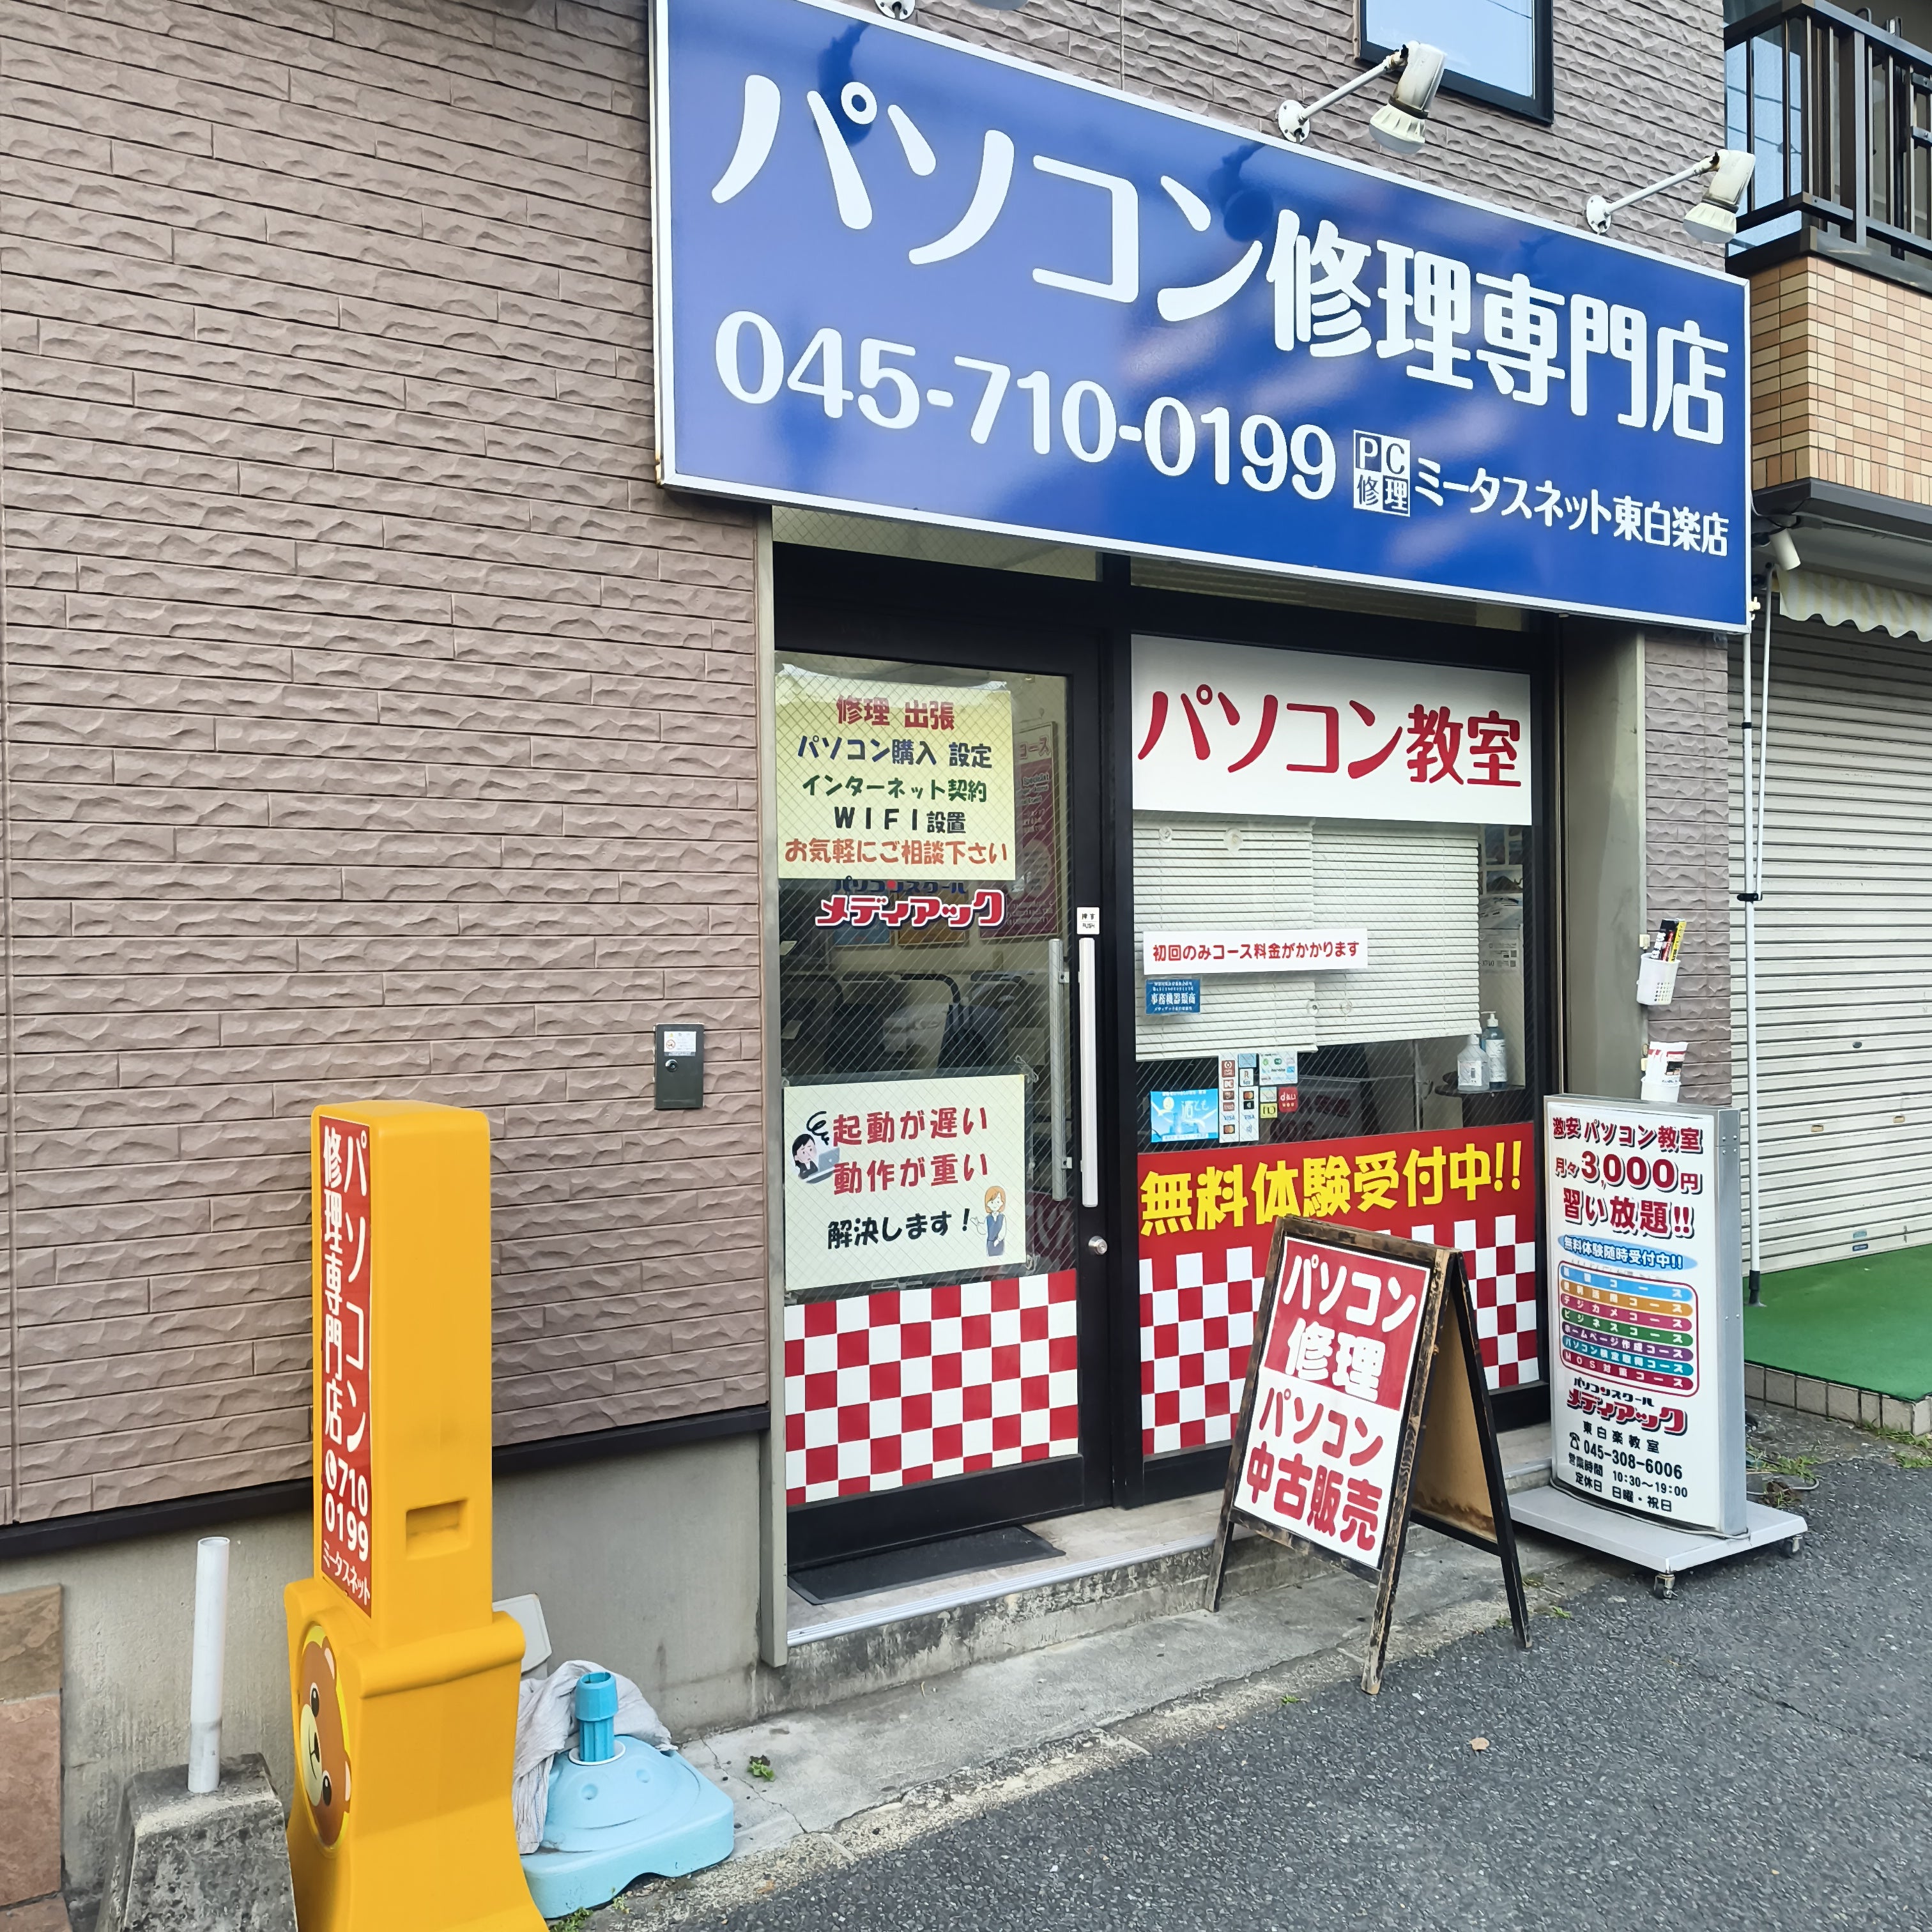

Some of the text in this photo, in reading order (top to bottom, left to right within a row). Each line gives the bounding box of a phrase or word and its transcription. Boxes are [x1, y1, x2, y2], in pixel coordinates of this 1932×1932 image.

[712, 75, 1729, 445] パソコン修理専門店
[716, 310, 1336, 500] 045-710-0199
[1360, 436, 1406, 474] PC
[1357, 475, 1408, 511] 修理
[1415, 457, 1729, 557] ミータスネット東白楽店
[837, 695, 955, 731] 修理 出張
[797, 735, 992, 769] パソコン購入 設定
[1138, 684, 1521, 786] パソコン教室
[802, 774, 987, 802] インターネット契約
[785, 838, 1007, 866] お気軽にご相談下さい
[834, 876, 966, 894] パソコンスクール
[815, 889, 1006, 929] メディアック
[1153, 940, 1360, 962] 初回のみコース料金がかかります
[832, 1107, 988, 1147] 起動が遅い
[832, 1153, 988, 1195] 動作が重い
[1140, 1140, 1522, 1237] 無料体験受付中!!
[1563, 1188, 1695, 1239] 習い放題!!
[323, 1126, 343, 1447] 修理専門店
[343, 1130, 368, 1453] パソコン
[1283, 1254, 1416, 1333] パソコン
[1285, 1317, 1386, 1403] 修理
[1566, 1388, 1688, 1436] メディアック
[1574, 1377, 1655, 1407] パソコンスクール
[1259, 1386, 1383, 1467] パソコン
[1583, 1420, 1660, 1454] 東白楽教室
[1568, 1452, 1604, 1477] 営業時間
[1583, 1439, 1683, 1480] 045-308-6006
[1246, 1441, 1383, 1552] 中古販売
[1575, 1471, 1602, 1493] 定休日
[325, 1492, 369, 1562] 0199
[323, 1539, 371, 1606] ミータスネット
